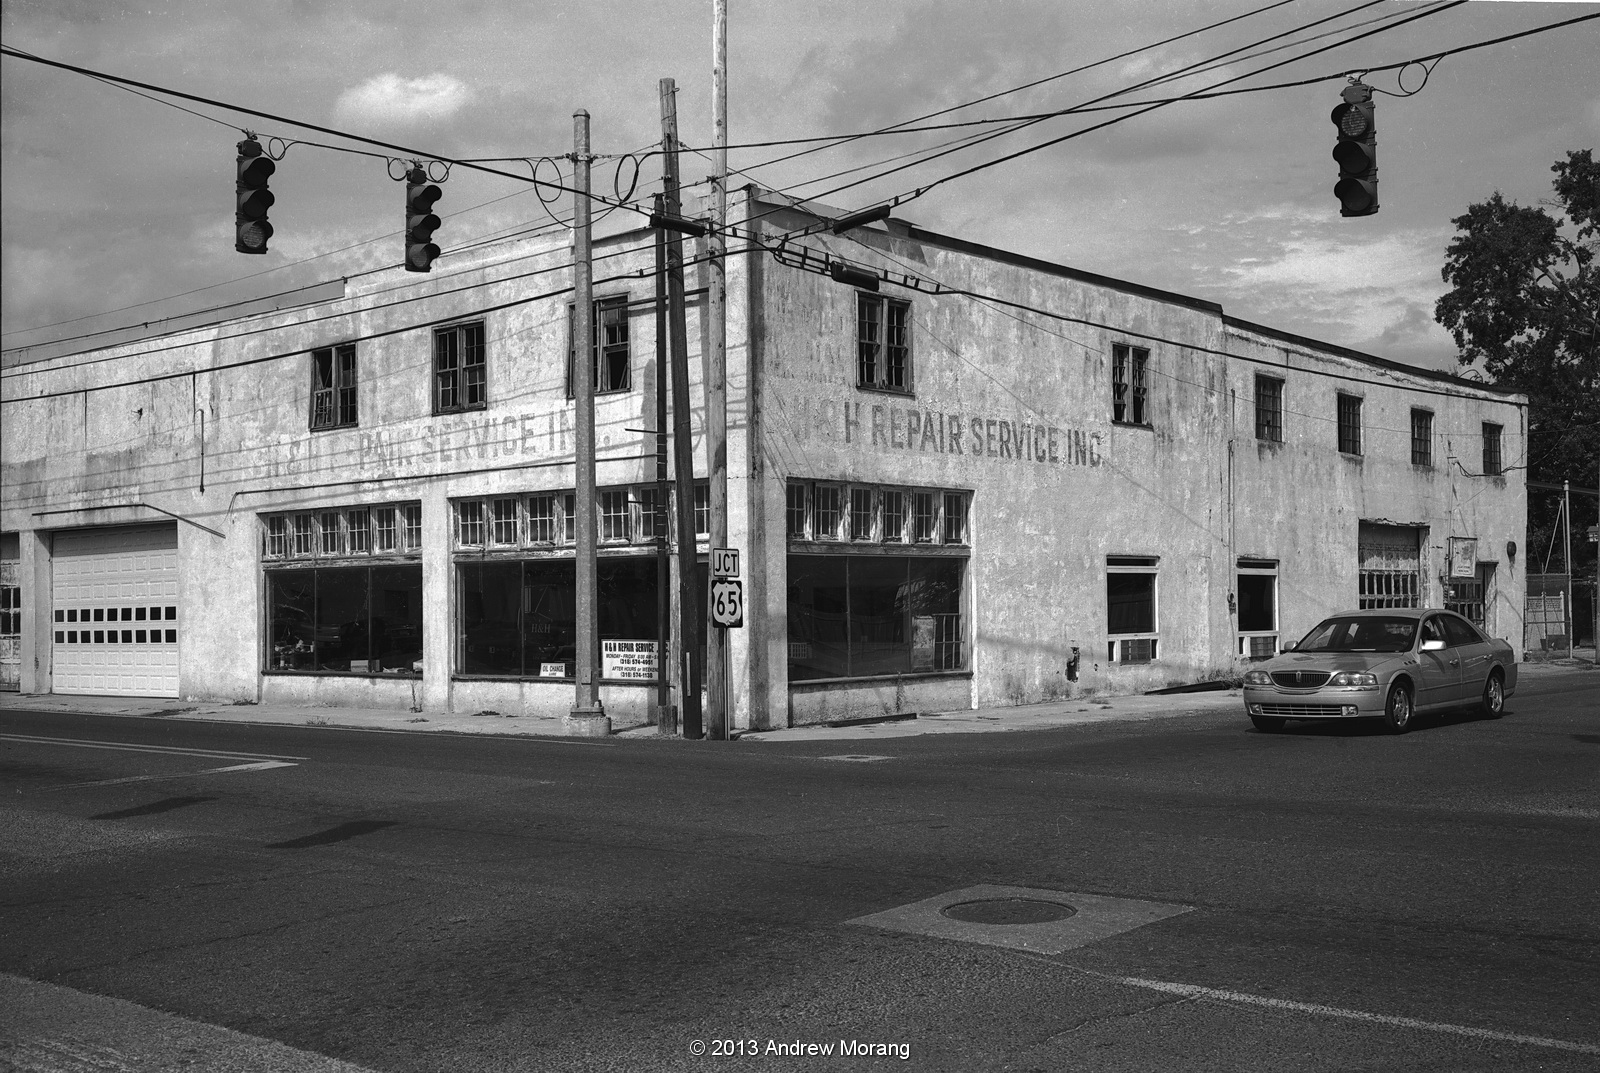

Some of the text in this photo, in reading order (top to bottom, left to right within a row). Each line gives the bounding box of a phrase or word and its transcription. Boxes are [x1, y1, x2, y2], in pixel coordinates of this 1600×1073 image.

[421, 412, 537, 463] SERVICE
[844, 401, 860, 443] H
[872, 404, 963, 454] REPAIR
[970, 416, 1058, 463] SERVICE
[715, 553, 738, 573] JCT
[716, 591, 737, 616] 65
[618, 642, 634, 652] REPAIR
[635, 642, 654, 653] SERVICE
